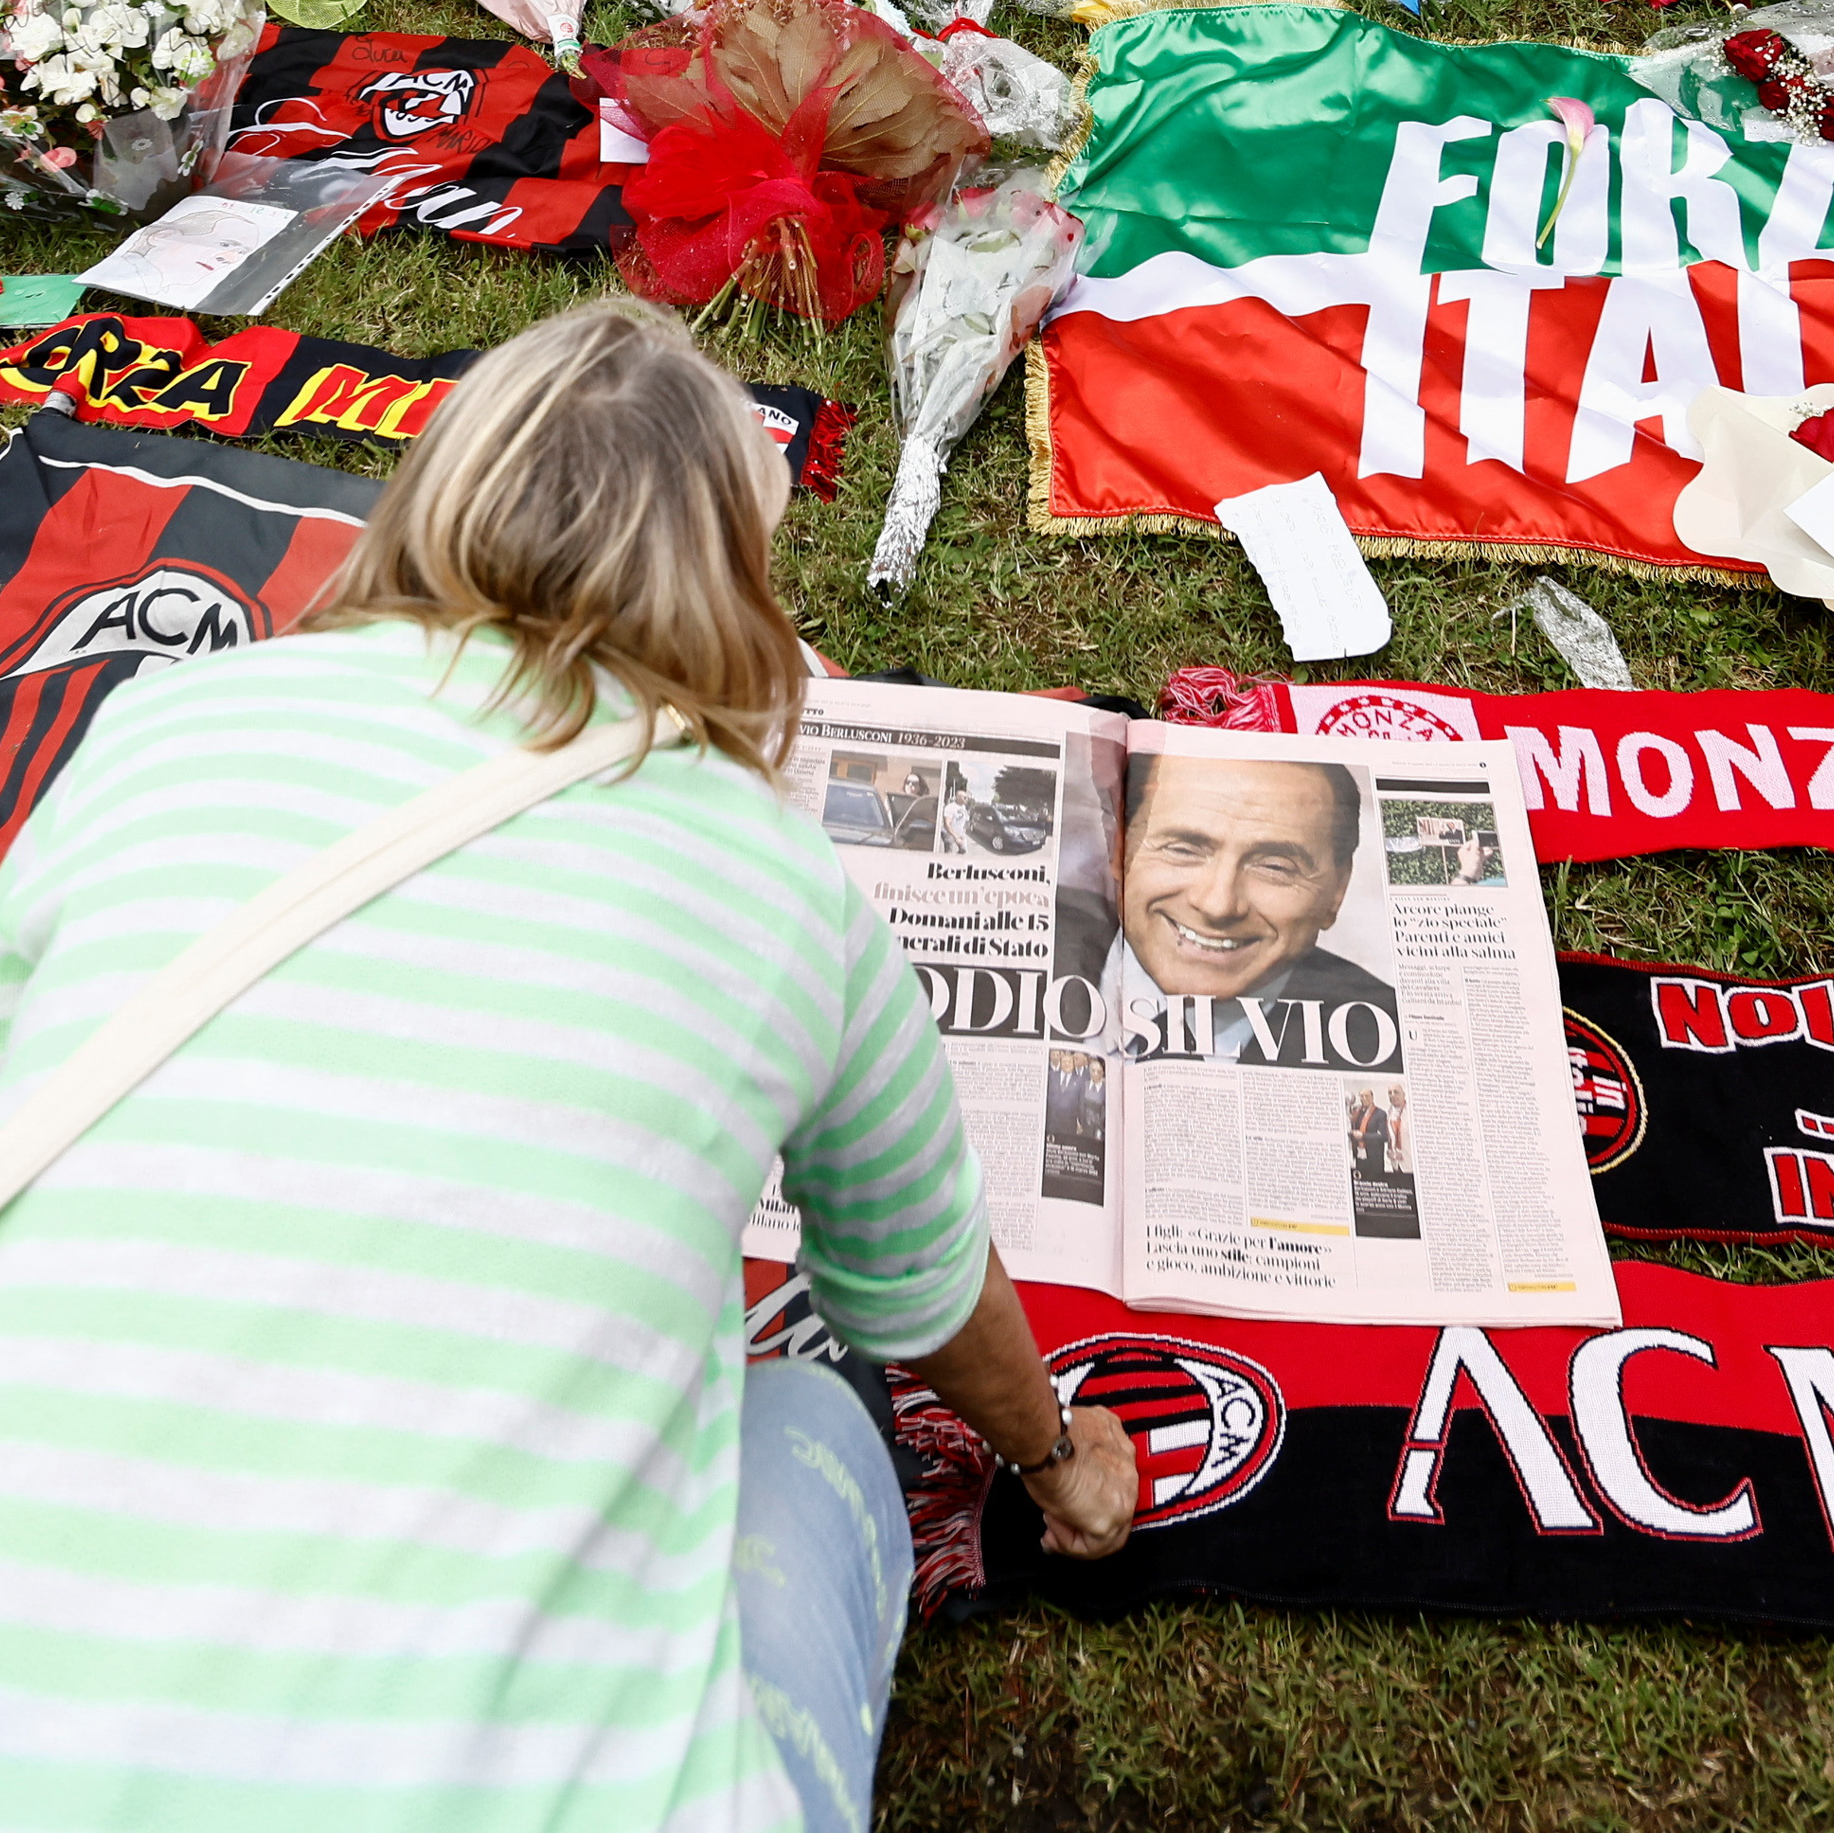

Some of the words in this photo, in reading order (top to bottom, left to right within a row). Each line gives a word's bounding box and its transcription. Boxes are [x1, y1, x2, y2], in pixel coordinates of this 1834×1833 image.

[69, 579, 247, 659] ACM
[1335, 708, 1434, 741] MONZA
[896, 733, 966, 750] 1936-2023
[927, 862, 1051, 886] Berlusconi,
[873, 881, 949, 904] finisce
[949, 886, 1049, 908] un'epoca
[889, 907, 983, 931] Domani
[983, 911, 1025, 930] alle
[1028, 912, 1050, 932] 15
[1393, 916, 1409, 928] lo
[900, 934, 962, 954] nerali
[963, 935, 986, 957] di
[986, 938, 1049, 958] Stato
[1441, 946, 1468, 959] alla
[1471, 948, 1517, 961] salma
[1121, 994, 1399, 1067] SILVIO
[1244, 1233, 1267, 1250] per
[1146, 1240, 1188, 1255] Lascia
[1191, 1244, 1218, 1258] uno
[1255, 1253, 1321, 1272] campioni
[1199, 1262, 1271, 1284] ambizione
[1285, 1273, 1336, 1289] vittorie
[1211, 1368, 1260, 1472] ACM
[1386, 1326, 1763, 1543] AC
